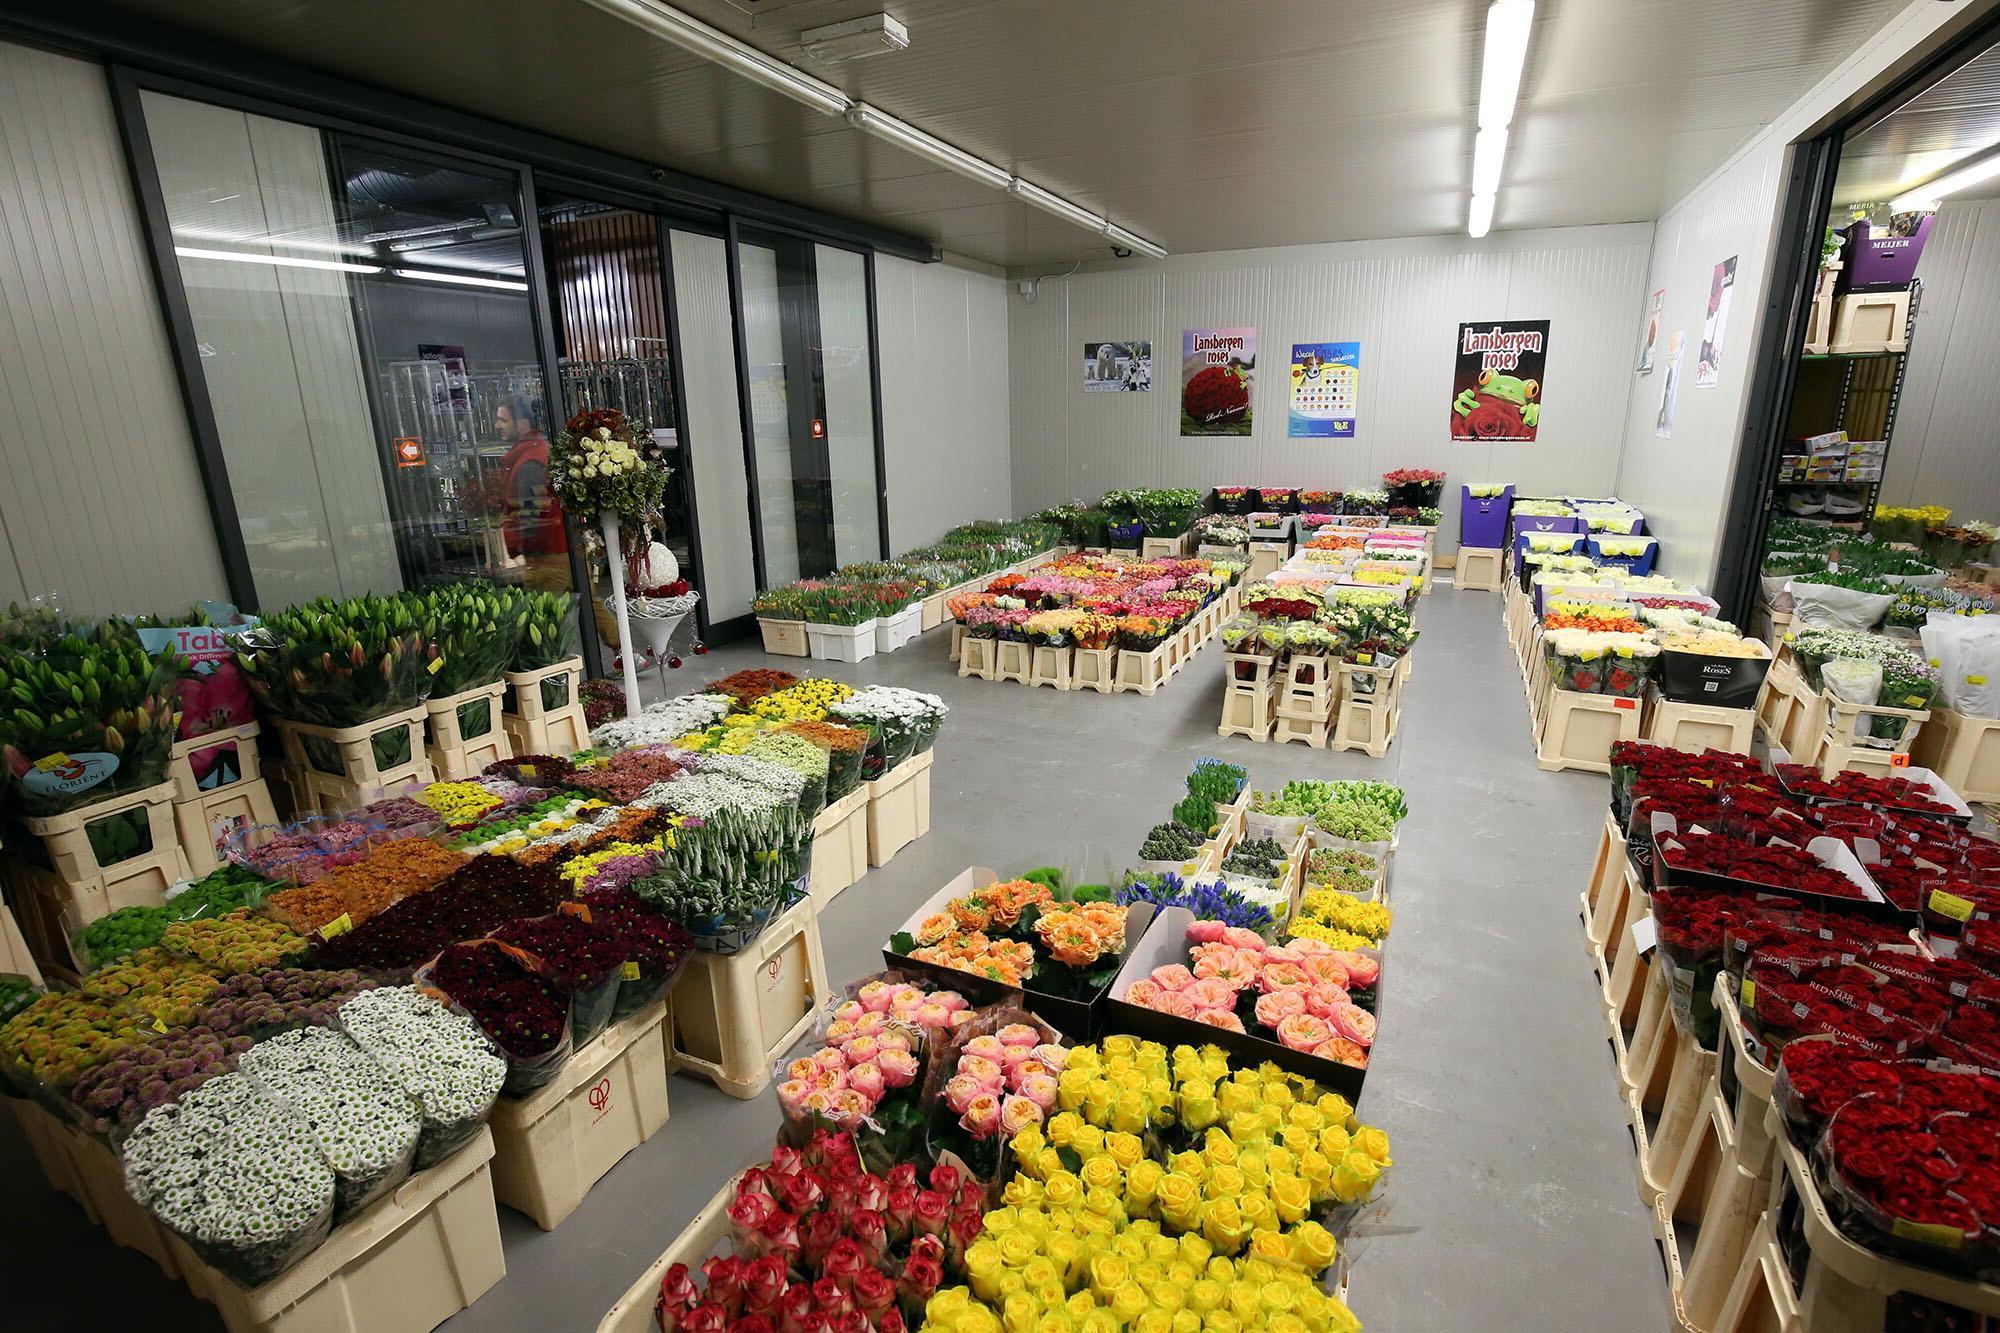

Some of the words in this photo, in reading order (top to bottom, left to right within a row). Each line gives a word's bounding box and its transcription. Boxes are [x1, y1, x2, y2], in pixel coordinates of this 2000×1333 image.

[1872, 240, 1910, 249] MEIJER
[1194, 334, 1244, 352] Lansbergen
[1464, 328, 1541, 353] Lansbergen
[1207, 351, 1229, 363] roses
[1484, 351, 1518, 369] roses
[45, 770, 106, 793] FLORIENT
[1820, 1021, 1841, 1036] RED
[1841, 1032, 1883, 1052] NAOMI!
